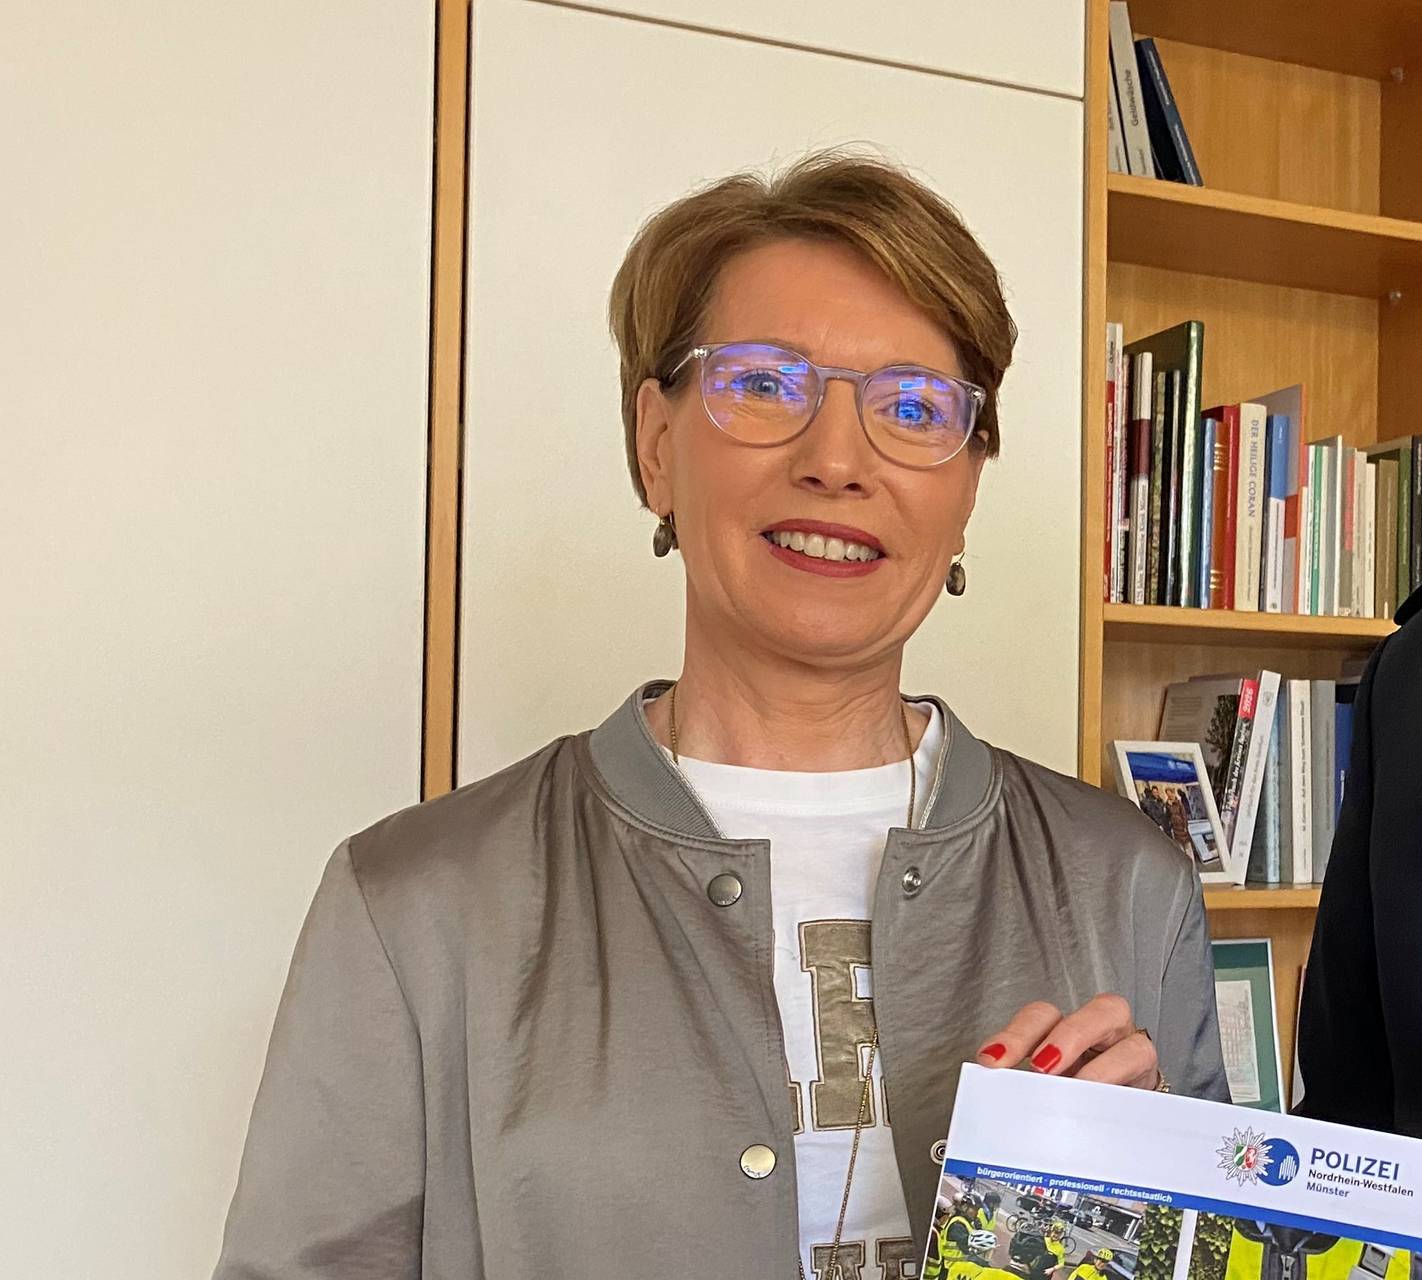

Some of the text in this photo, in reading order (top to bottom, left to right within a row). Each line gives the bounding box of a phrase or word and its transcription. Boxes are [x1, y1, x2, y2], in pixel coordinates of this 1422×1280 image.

[1250, 420, 1260, 438] DER
[1249, 441, 1259, 478] HEILIGE
[1247, 481, 1257, 518] CORAN
[1310, 1148, 1400, 1181] POLIZEI
[976, 1166, 1172, 1203] bürgerorientiert professionell rechtsstaatlich
[1306, 1181, 1350, 1198] Münster
[1308, 1169, 1414, 1197] Nordrhein-Westfalen
